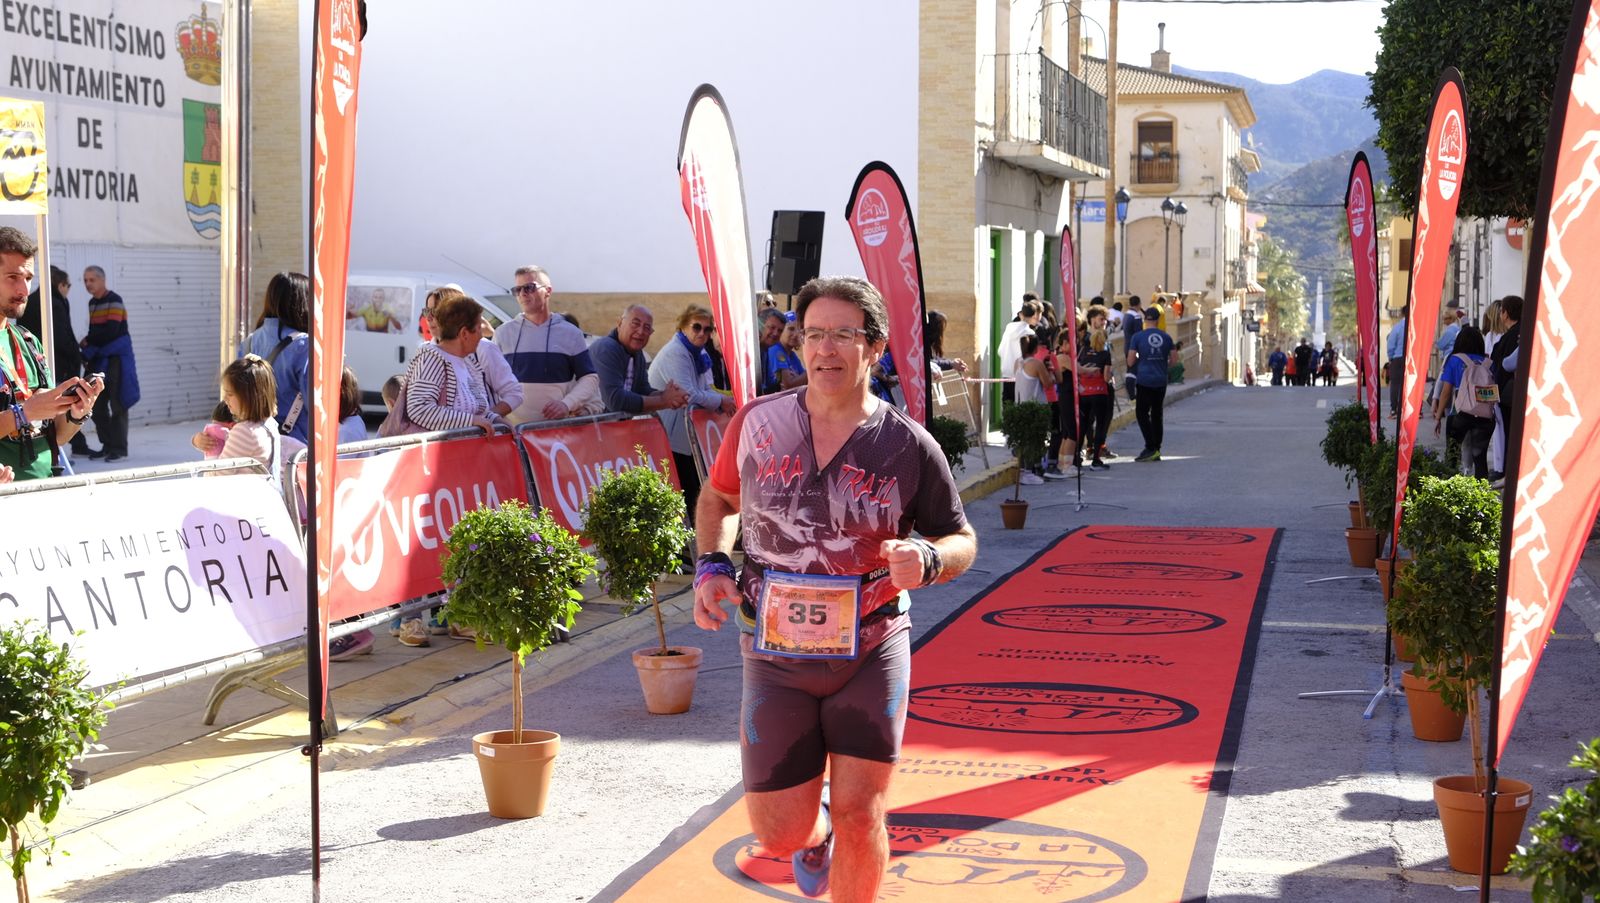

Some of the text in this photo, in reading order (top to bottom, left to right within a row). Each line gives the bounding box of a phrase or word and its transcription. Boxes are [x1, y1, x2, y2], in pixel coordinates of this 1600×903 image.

[2, 1, 166, 60] EXCELENTÍSIMO
[9, 55, 166, 108] AYUNTAMIENTO
[76, 117, 103, 150] DE
[755, 454, 804, 488] VARA
[835, 463, 897, 509] TRAIL
[0, 517, 271, 577] YUNTAMIENTO DE
[868, 567, 889, 581] DORSA
[0, 549, 289, 635] ANTORIA
[787, 602, 827, 626] 35
[898, 767, 1122, 786] Ayuntamien
[888, 834, 1098, 854] LA POLV
